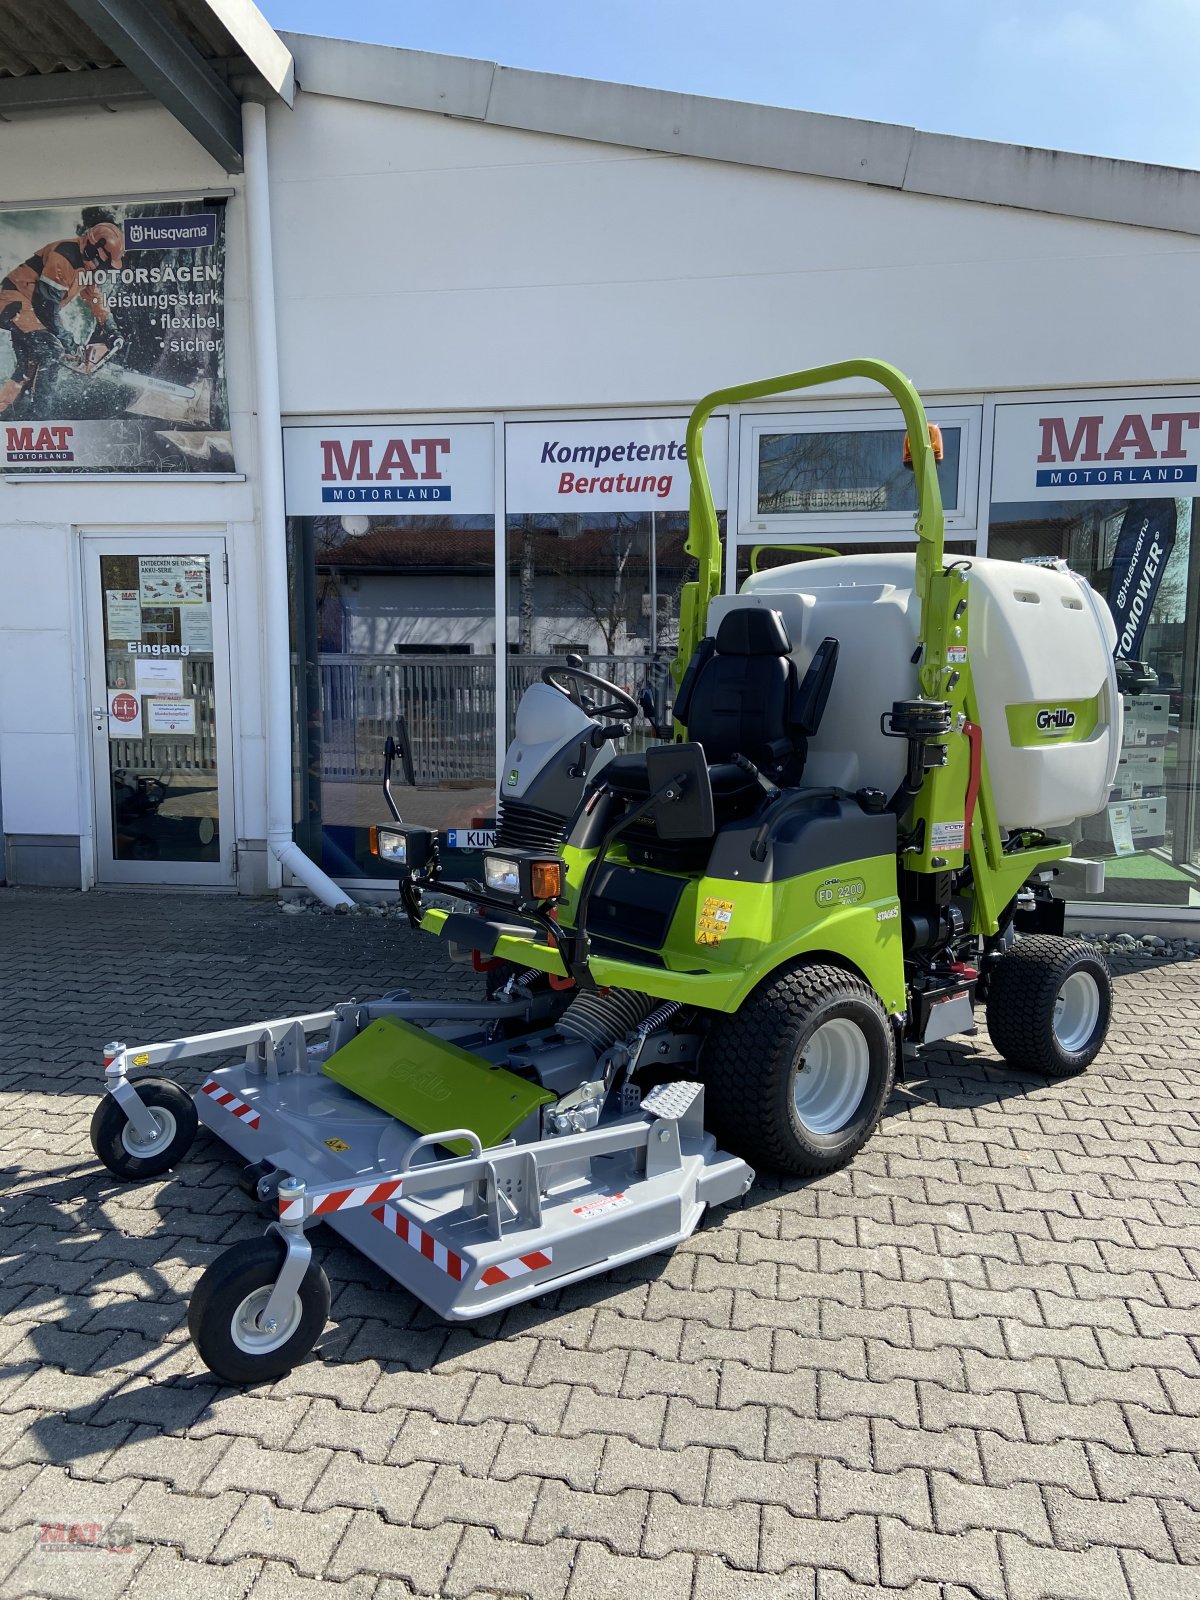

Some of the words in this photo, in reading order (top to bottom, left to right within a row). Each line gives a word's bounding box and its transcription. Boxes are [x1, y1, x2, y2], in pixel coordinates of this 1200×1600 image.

[144, 226, 207, 240] Husqvarna
[78, 264, 218, 285] MOTORSÄGEN
[103, 289, 219, 310] leistungsstark
[160, 313, 220, 329] flexibel
[170, 337, 221, 352] sicher
[5, 426, 74, 451] MAT
[1037, 412, 1199, 463] MAT
[321, 438, 450, 481] MAT
[558, 472, 673, 498] Beratung
[1050, 468, 1184, 484] MOTORLAND
[333, 488, 441, 500] MOTORLAND
[1121, 518, 1149, 594] Husqvarna
[127, 641, 190, 656] Eingang
[1036, 708, 1076, 730] Grillo
[448, 832, 456, 844] P
[819, 889, 833, 902] FD
[837, 883, 863, 898] 2200
